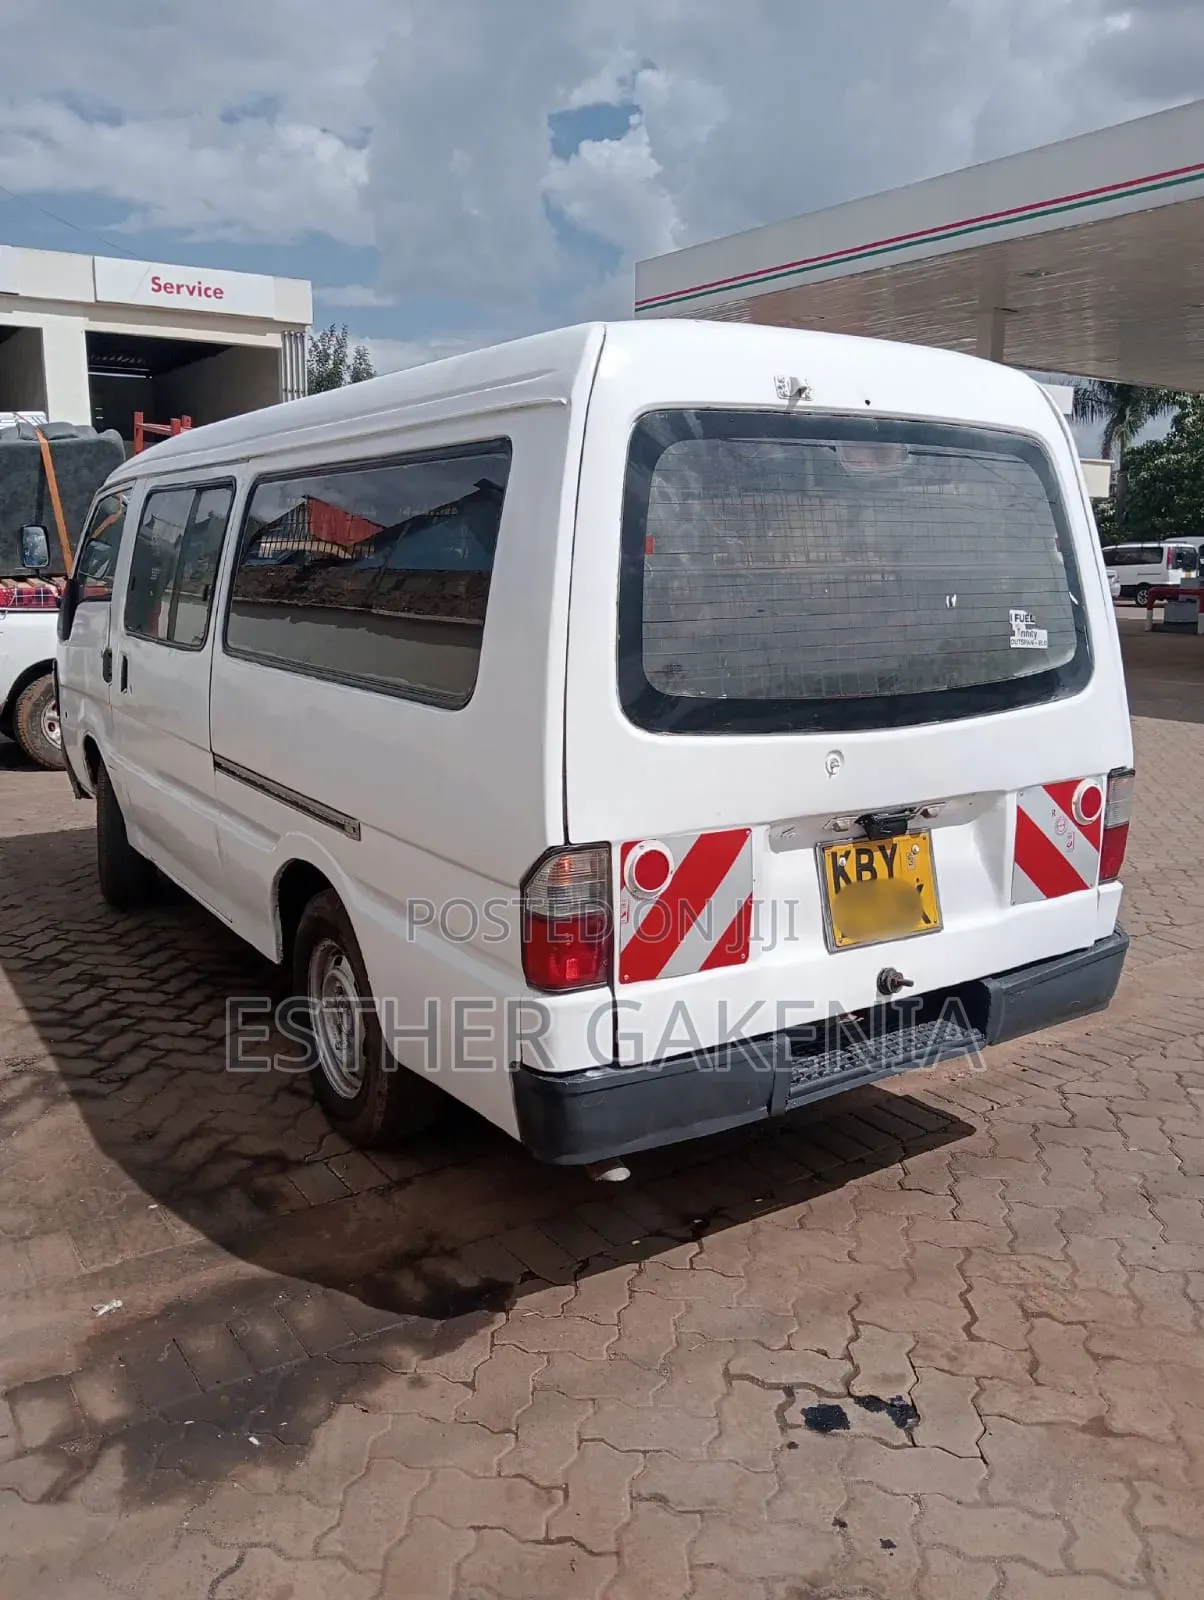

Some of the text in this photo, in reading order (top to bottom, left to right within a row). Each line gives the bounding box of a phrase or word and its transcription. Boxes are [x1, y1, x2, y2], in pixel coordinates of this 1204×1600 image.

[151, 276, 224, 299] Service
[1014, 613, 1035, 623] FUEL
[831, 843, 898, 895] KBY
